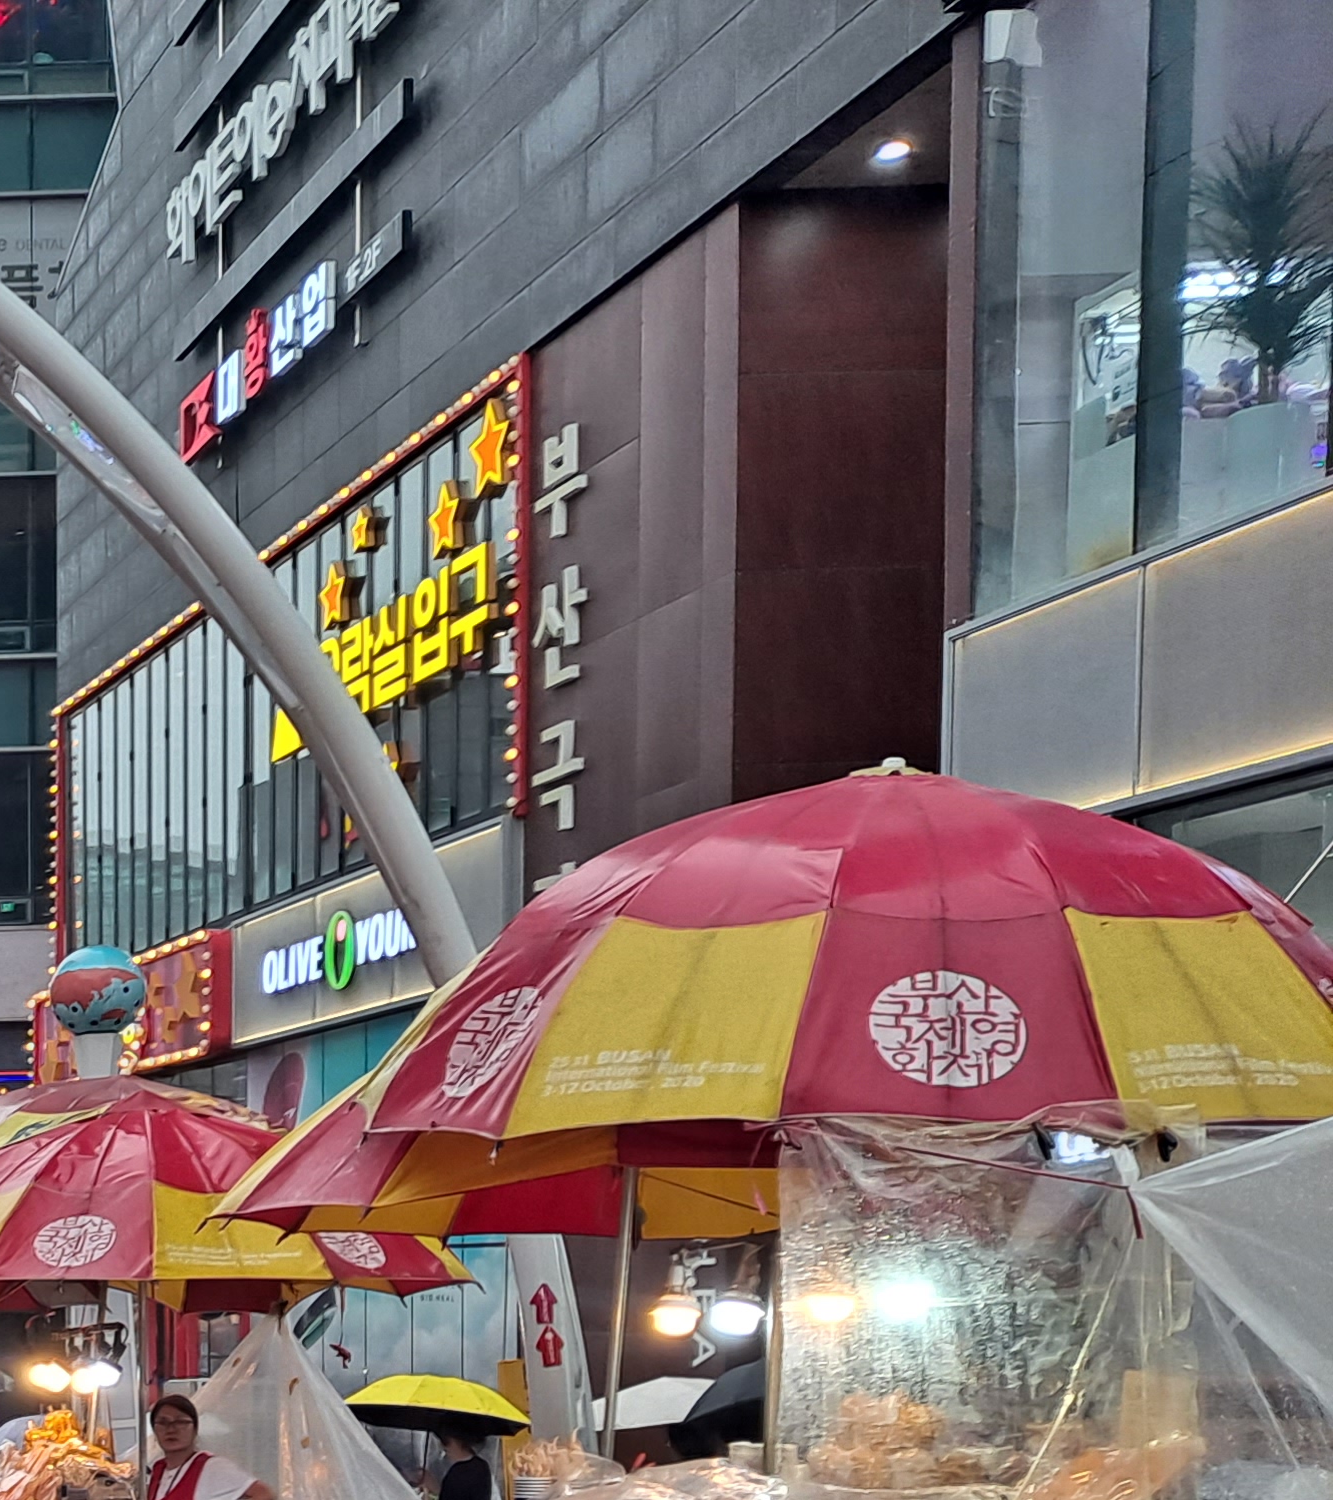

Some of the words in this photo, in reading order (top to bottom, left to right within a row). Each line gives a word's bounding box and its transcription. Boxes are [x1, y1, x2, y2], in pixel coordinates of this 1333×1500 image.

[532, 423, 589, 893] 부산극
[261, 935, 325, 994] OLIVE
[353, 907, 418, 966] YOUN
[595, 1047, 671, 1064] BUSAN
